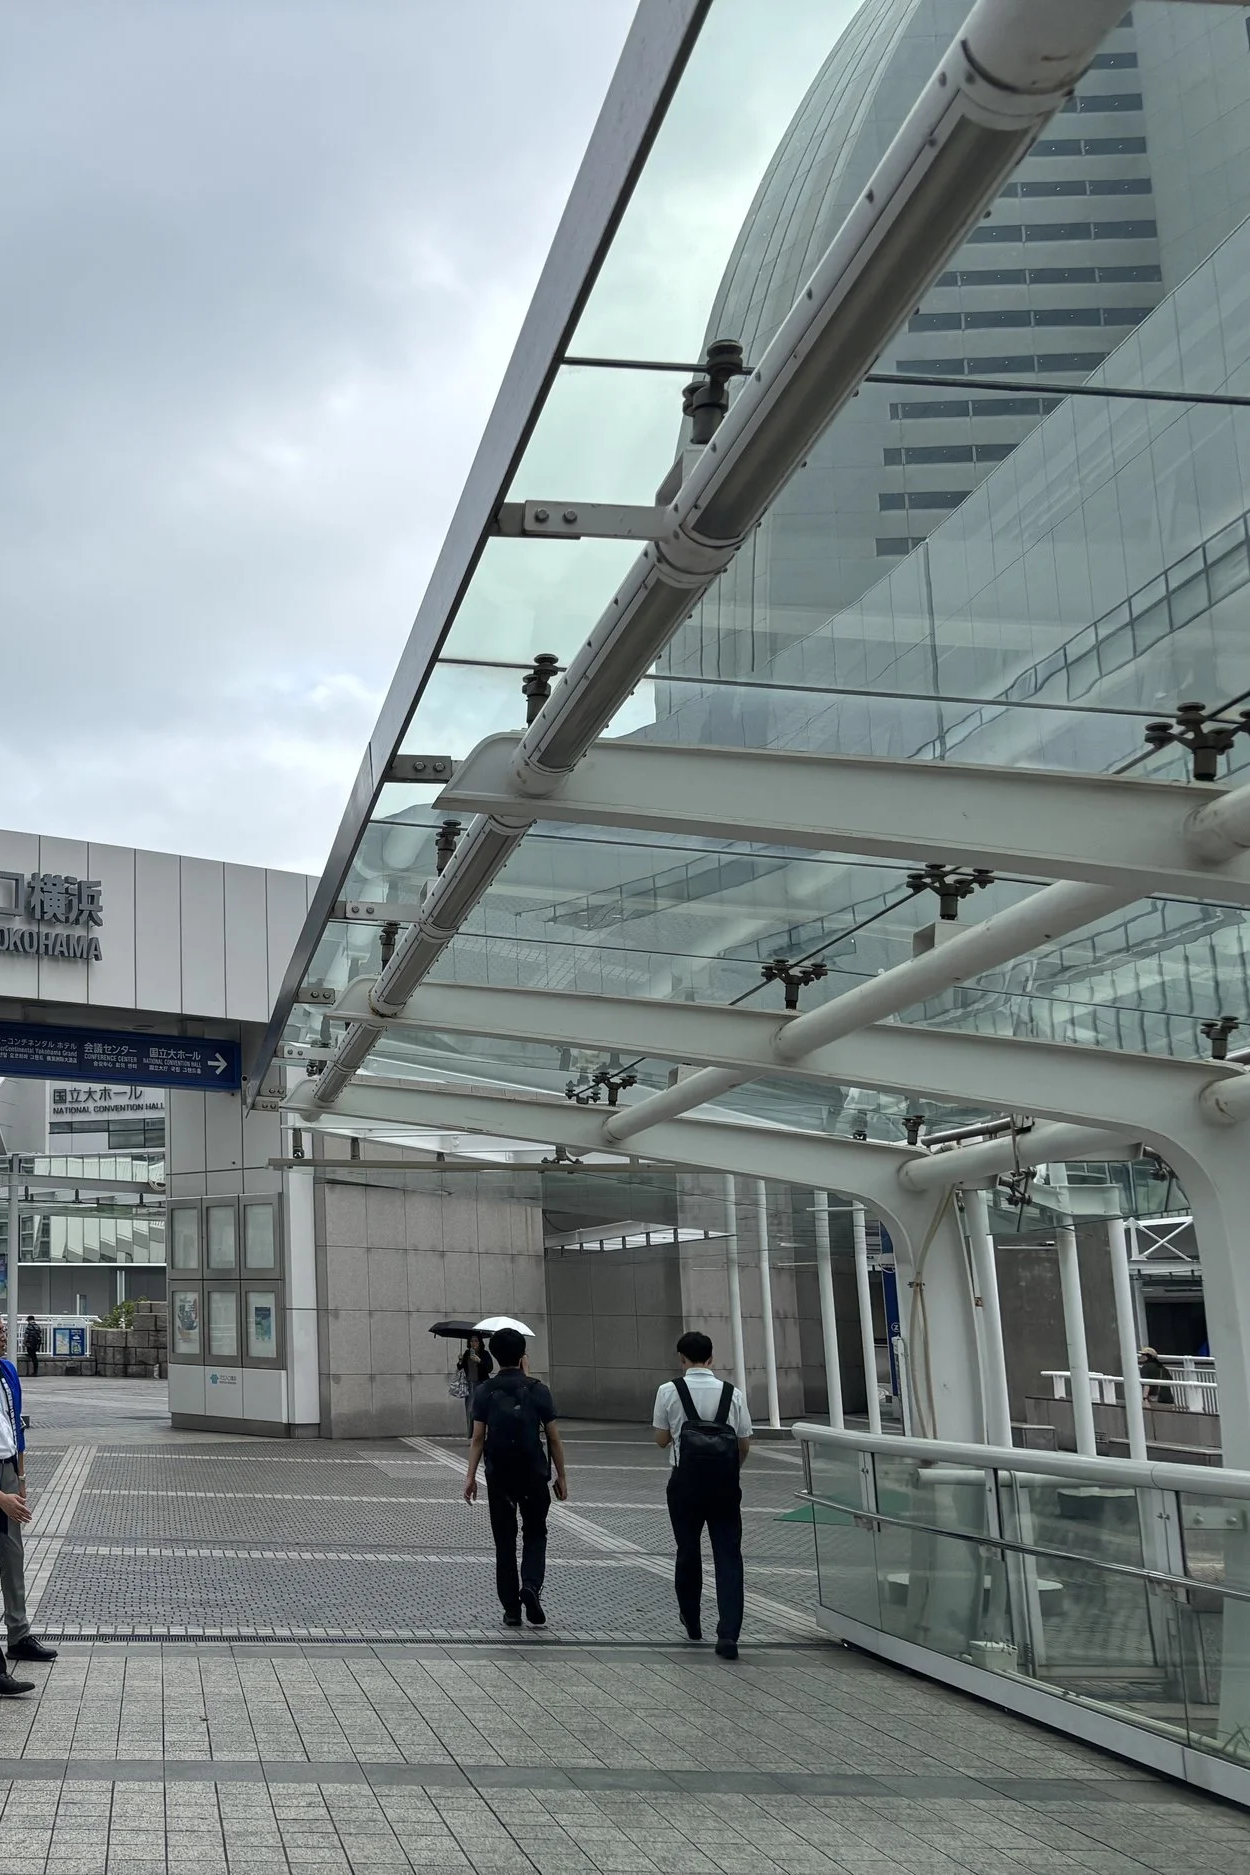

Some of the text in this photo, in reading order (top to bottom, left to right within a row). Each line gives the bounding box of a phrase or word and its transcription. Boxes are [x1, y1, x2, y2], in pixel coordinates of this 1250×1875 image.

[56, 1041, 77, 1050] ホテル
[84, 1042, 138, 1055] 会議センター
[84, 1053, 138, 1063] CONFERENCE CENTER
[149, 1047, 201, 1060] 国立大ホール
[53, 1086, 143, 1104] 国立大ホール
[53, 1102, 165, 1115] NATIONAL CONVENTION HALL
